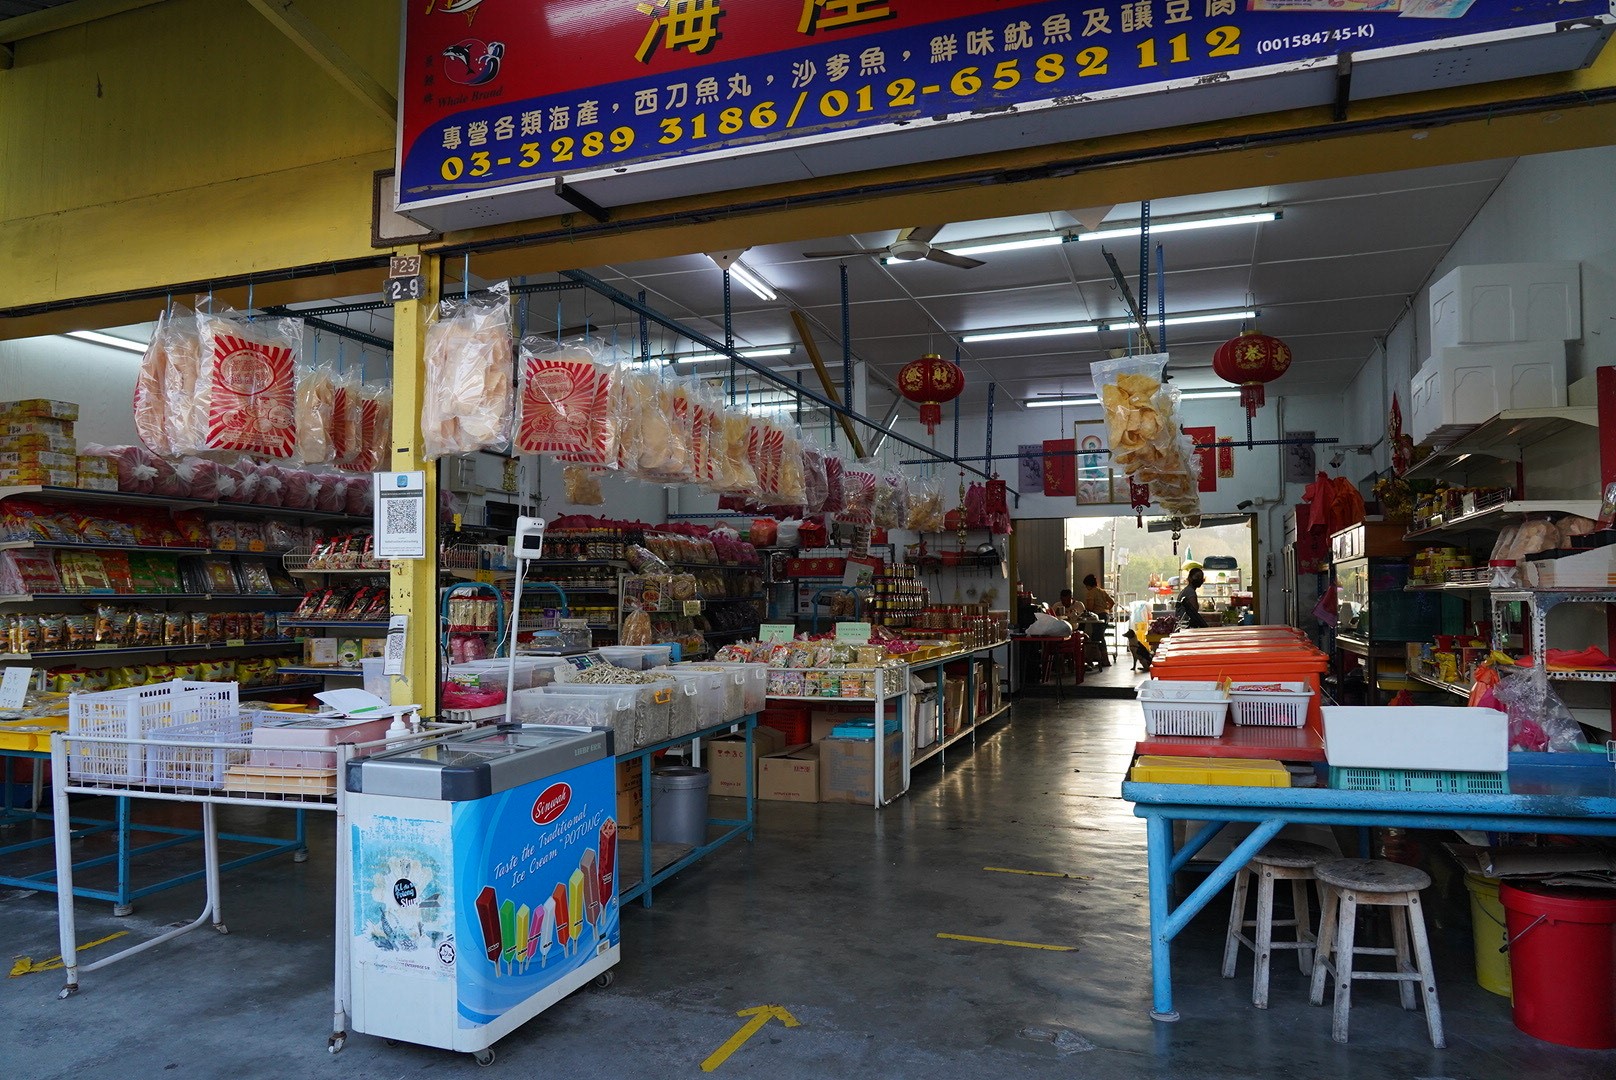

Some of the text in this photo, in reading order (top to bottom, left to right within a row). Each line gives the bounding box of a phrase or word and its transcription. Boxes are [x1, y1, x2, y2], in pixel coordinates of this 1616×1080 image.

[1256, 23, 1376, 55] (001584745-K)
[440, 126, 635, 181] 03-3289
[1136, 25, 1241, 69] 112
[472, 87, 504, 101] Brand
[392, 278, 419, 300] 2-9
[494, 803, 587, 880] Taste the Traditional
[511, 870, 526, 889] Ice
[529, 849, 558, 874] Cream
